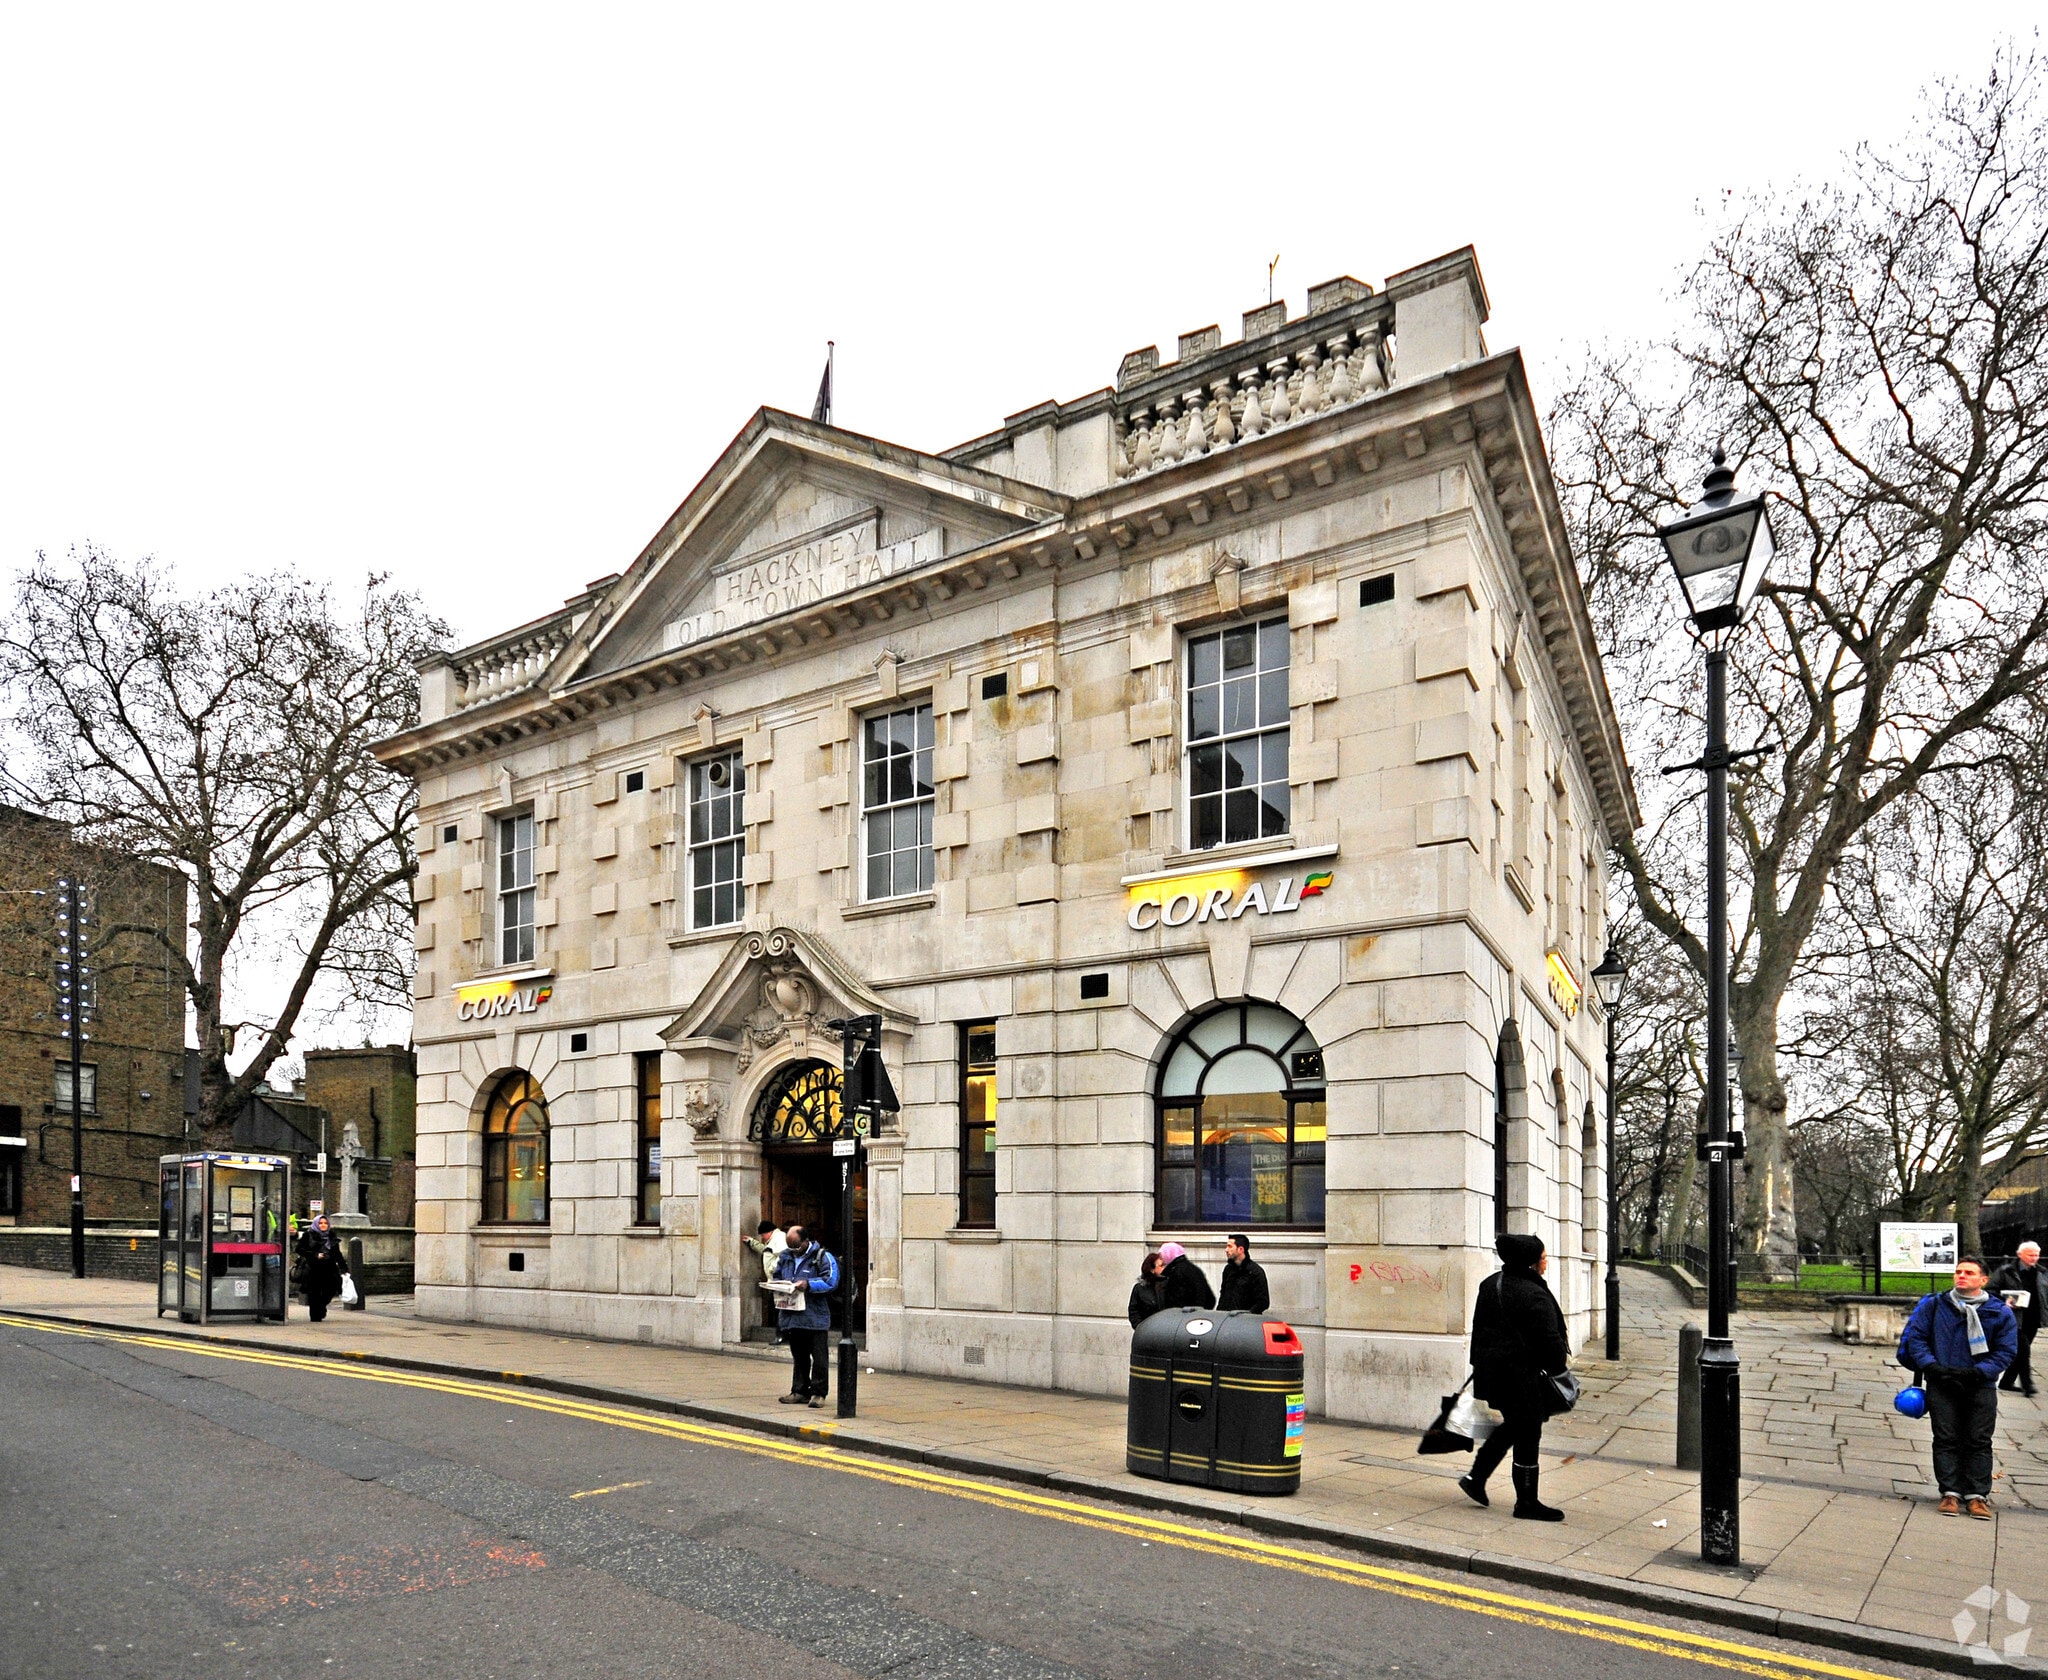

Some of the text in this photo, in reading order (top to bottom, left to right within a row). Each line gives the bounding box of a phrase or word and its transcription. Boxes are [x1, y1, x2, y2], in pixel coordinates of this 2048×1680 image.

[727, 527, 867, 601] HACKNEY
[678, 540, 927, 645] OLD TOWN HALL
[1127, 877, 1300, 931] CORAL
[457, 989, 537, 1021] CORAL
[1254, 1154, 1271, 1165] THE
